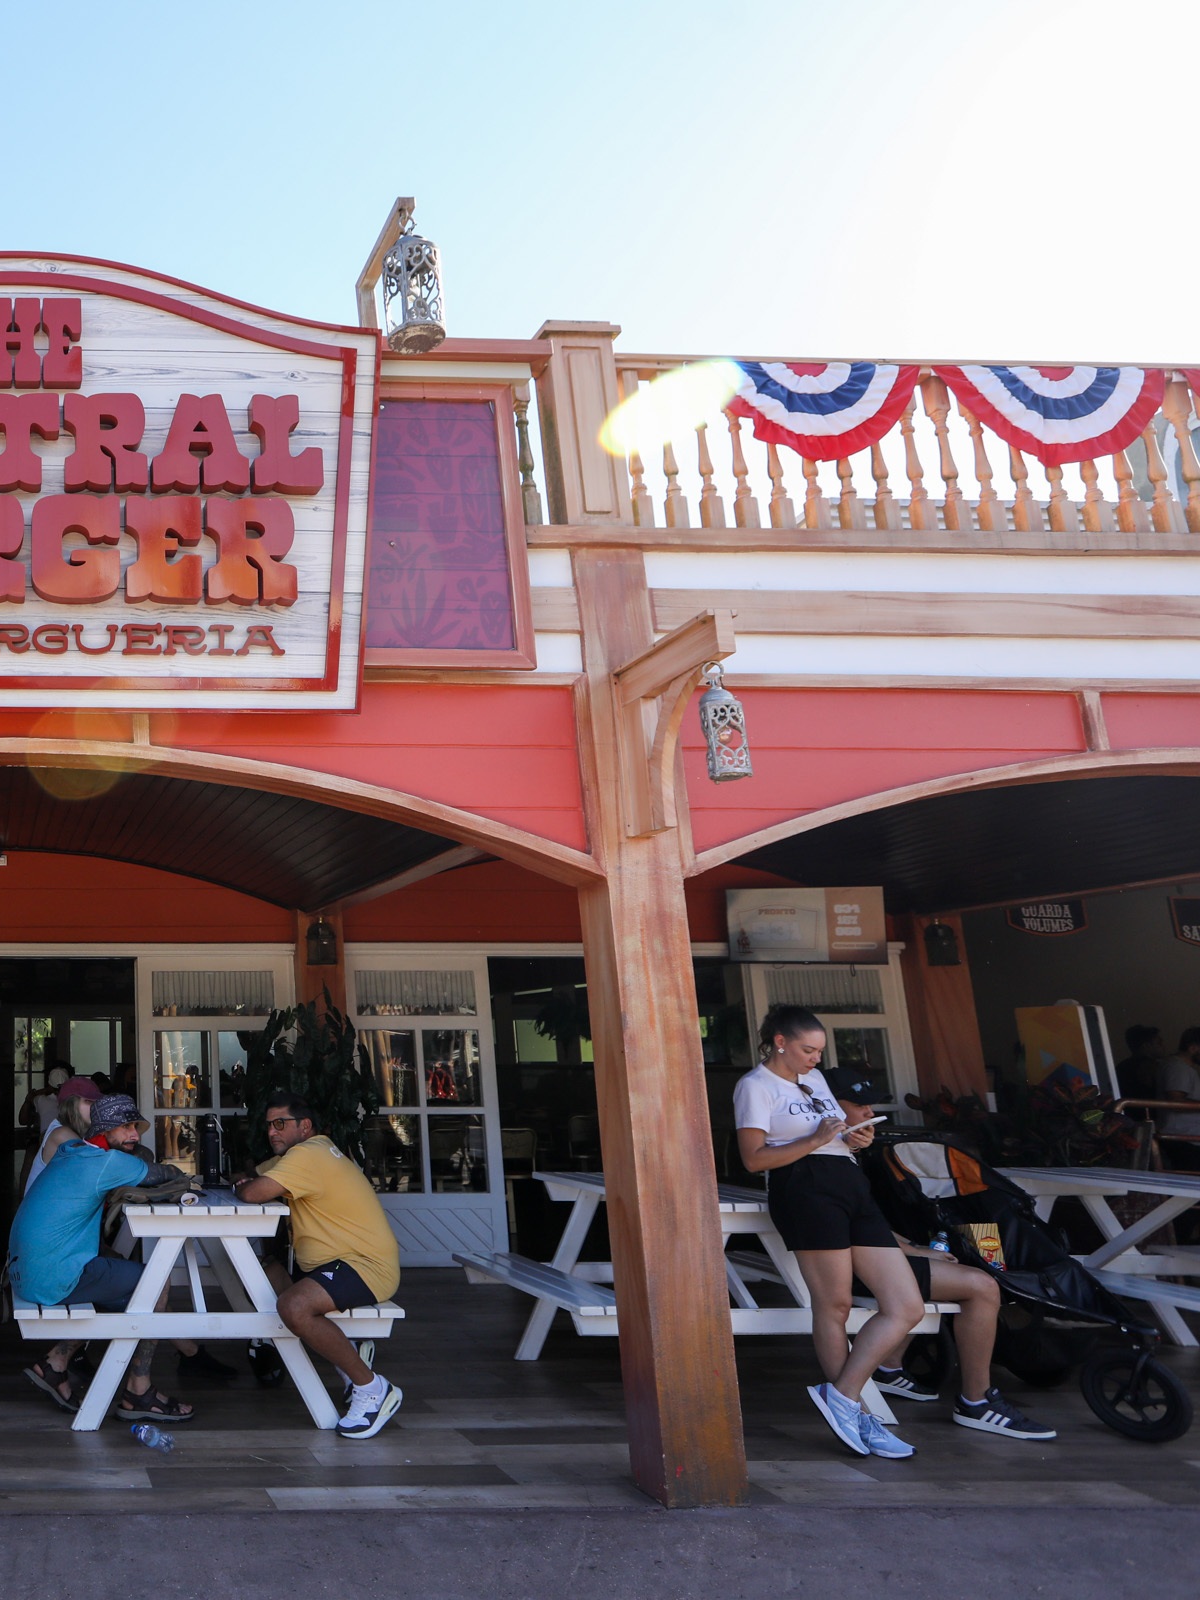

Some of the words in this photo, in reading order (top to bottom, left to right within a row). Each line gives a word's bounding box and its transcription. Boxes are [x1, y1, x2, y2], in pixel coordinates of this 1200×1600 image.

[1021, 904, 1072, 918] GUARDA
[1022, 918, 1075, 933] VOLUMES
[1182, 925, 1200, 941] SA
